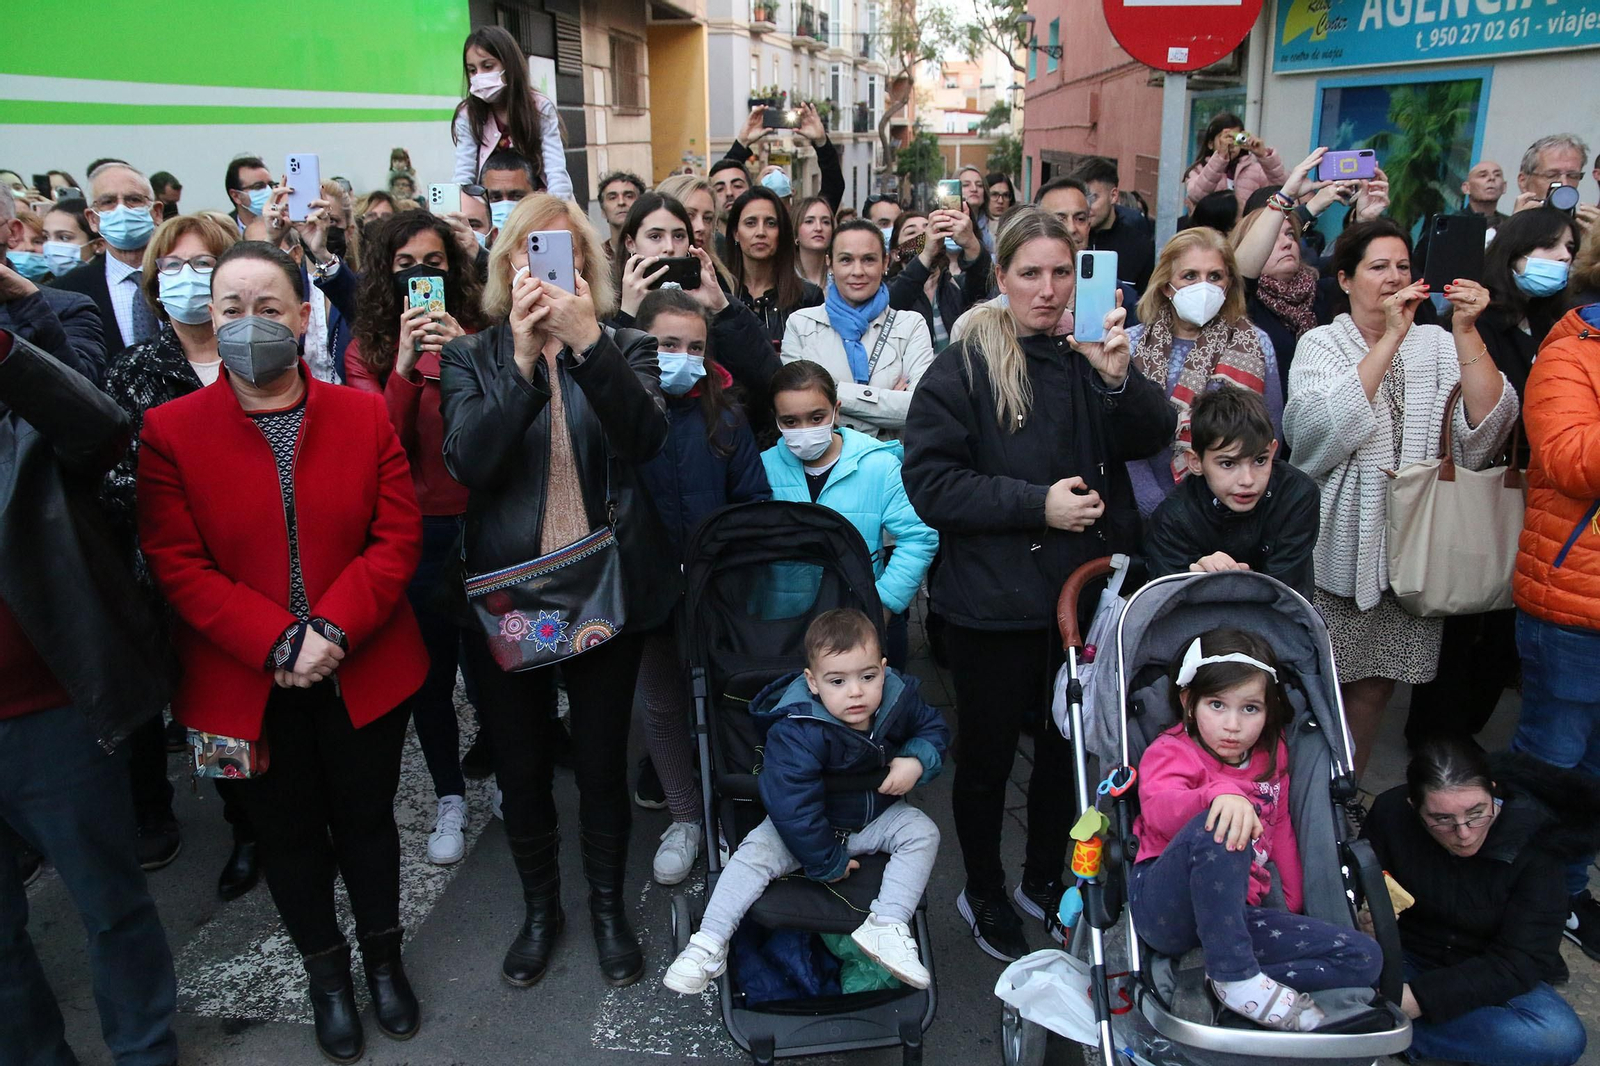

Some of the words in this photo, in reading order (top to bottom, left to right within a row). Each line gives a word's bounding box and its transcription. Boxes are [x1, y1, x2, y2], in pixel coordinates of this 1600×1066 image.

[1460, 22, 1482, 44] 27
[1484, 20, 1505, 42] 02
[1508, 17, 1530, 38] 61
[1310, 47, 1320, 60] de
